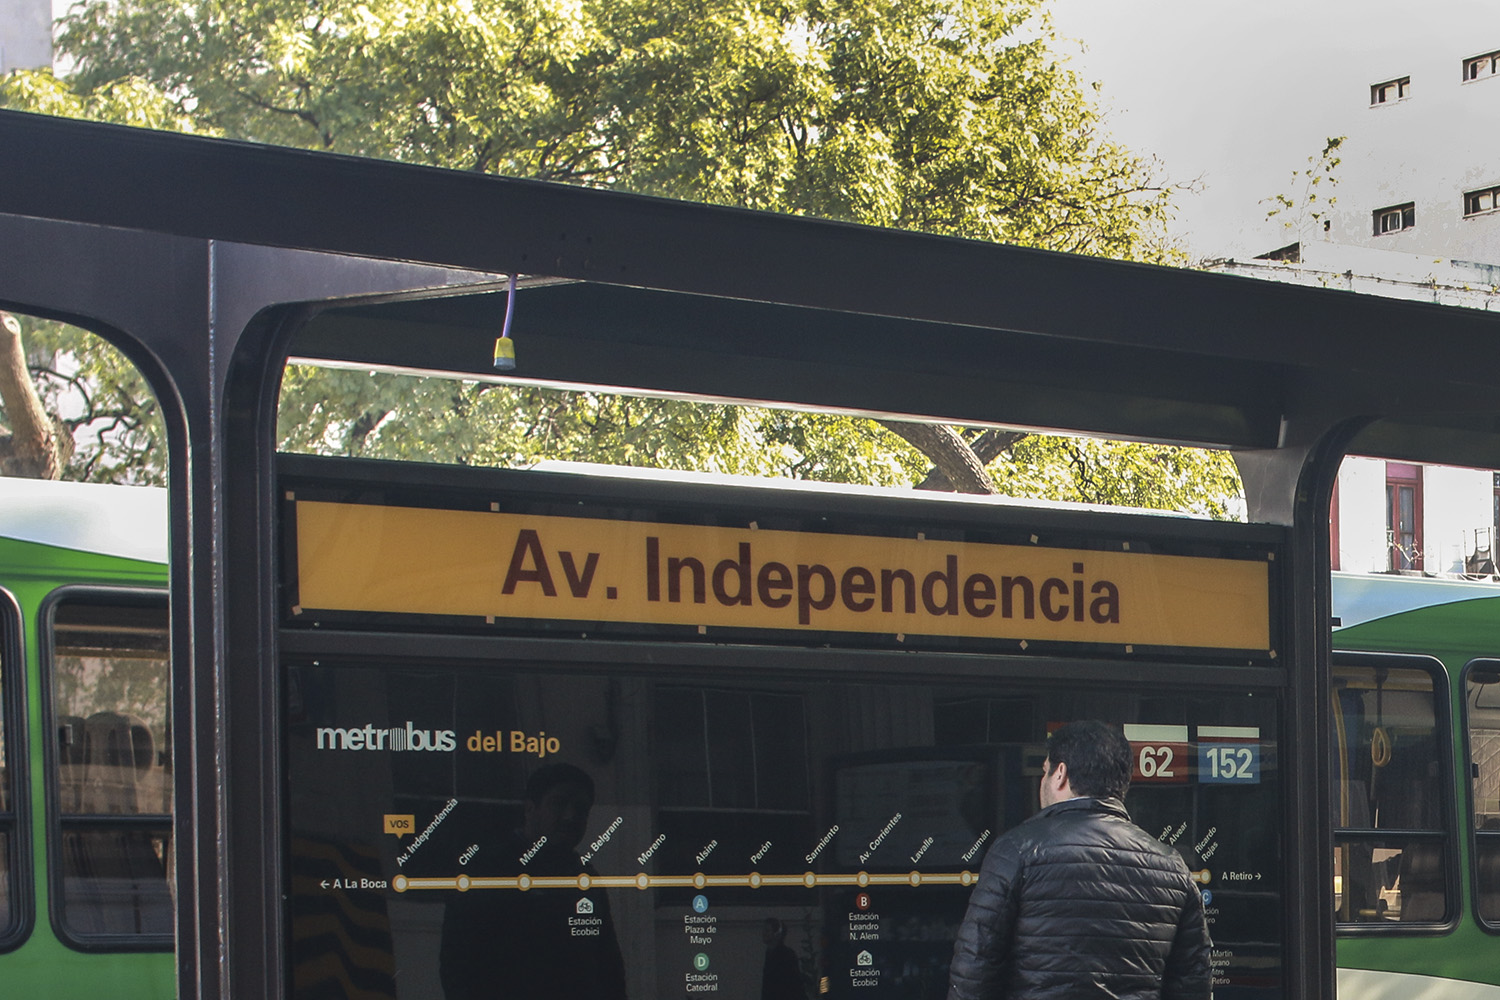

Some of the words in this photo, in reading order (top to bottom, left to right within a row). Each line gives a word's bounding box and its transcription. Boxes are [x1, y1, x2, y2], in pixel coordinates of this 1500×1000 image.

[501, 529, 618, 599] Av.
[646, 536, 1120, 625] Independencia
[467, 730, 501, 752] del
[510, 731, 560, 758] Bajo
[1139, 746, 1174, 778] 62
[1206, 748, 1253, 779] 152
[390, 820, 409, 829] VOS
[396, 853, 411, 867] Av.
[407, 798, 458, 854] Independencia
[1170, 821, 1187, 846] Alvear
[520, 835, 547, 866] México
[580, 852, 594, 866] Av.
[590, 816, 623, 851] Belgrano
[637, 833, 666, 865] Moreno
[805, 824, 840, 864] Sarmiento
[859, 851, 872, 864] Av.
[869, 812, 902, 851] Corrientes
[910, 836, 934, 864] Lavalle
[961, 829, 991, 863] Tucumán
[1194, 826, 1217, 854] Ricardo
[459, 842, 480, 866] Chile
[695, 839, 718, 865] Alsina
[750, 840, 772, 865] Perón
[1201, 842, 1218, 862] Rojas
[333, 879, 342, 889] A
[345, 879, 358, 889] La
[361, 879, 387, 889] Boca
[1222, 872, 1228, 880] A
[1230, 872, 1253, 880] Retiro
[568, 916, 602, 926] Estación
[684, 915, 717, 923] Estación
[848, 912, 880, 920] Estación
[571, 927, 600, 936] Ecobici
[690, 936, 712, 945] Mayo
[860, 932, 879, 940] Alem
[685, 972, 718, 981] Estación
[849, 968, 881, 977] Estación
[852, 978, 878, 987] Ecobici
[686, 983, 718, 991] Catedral
